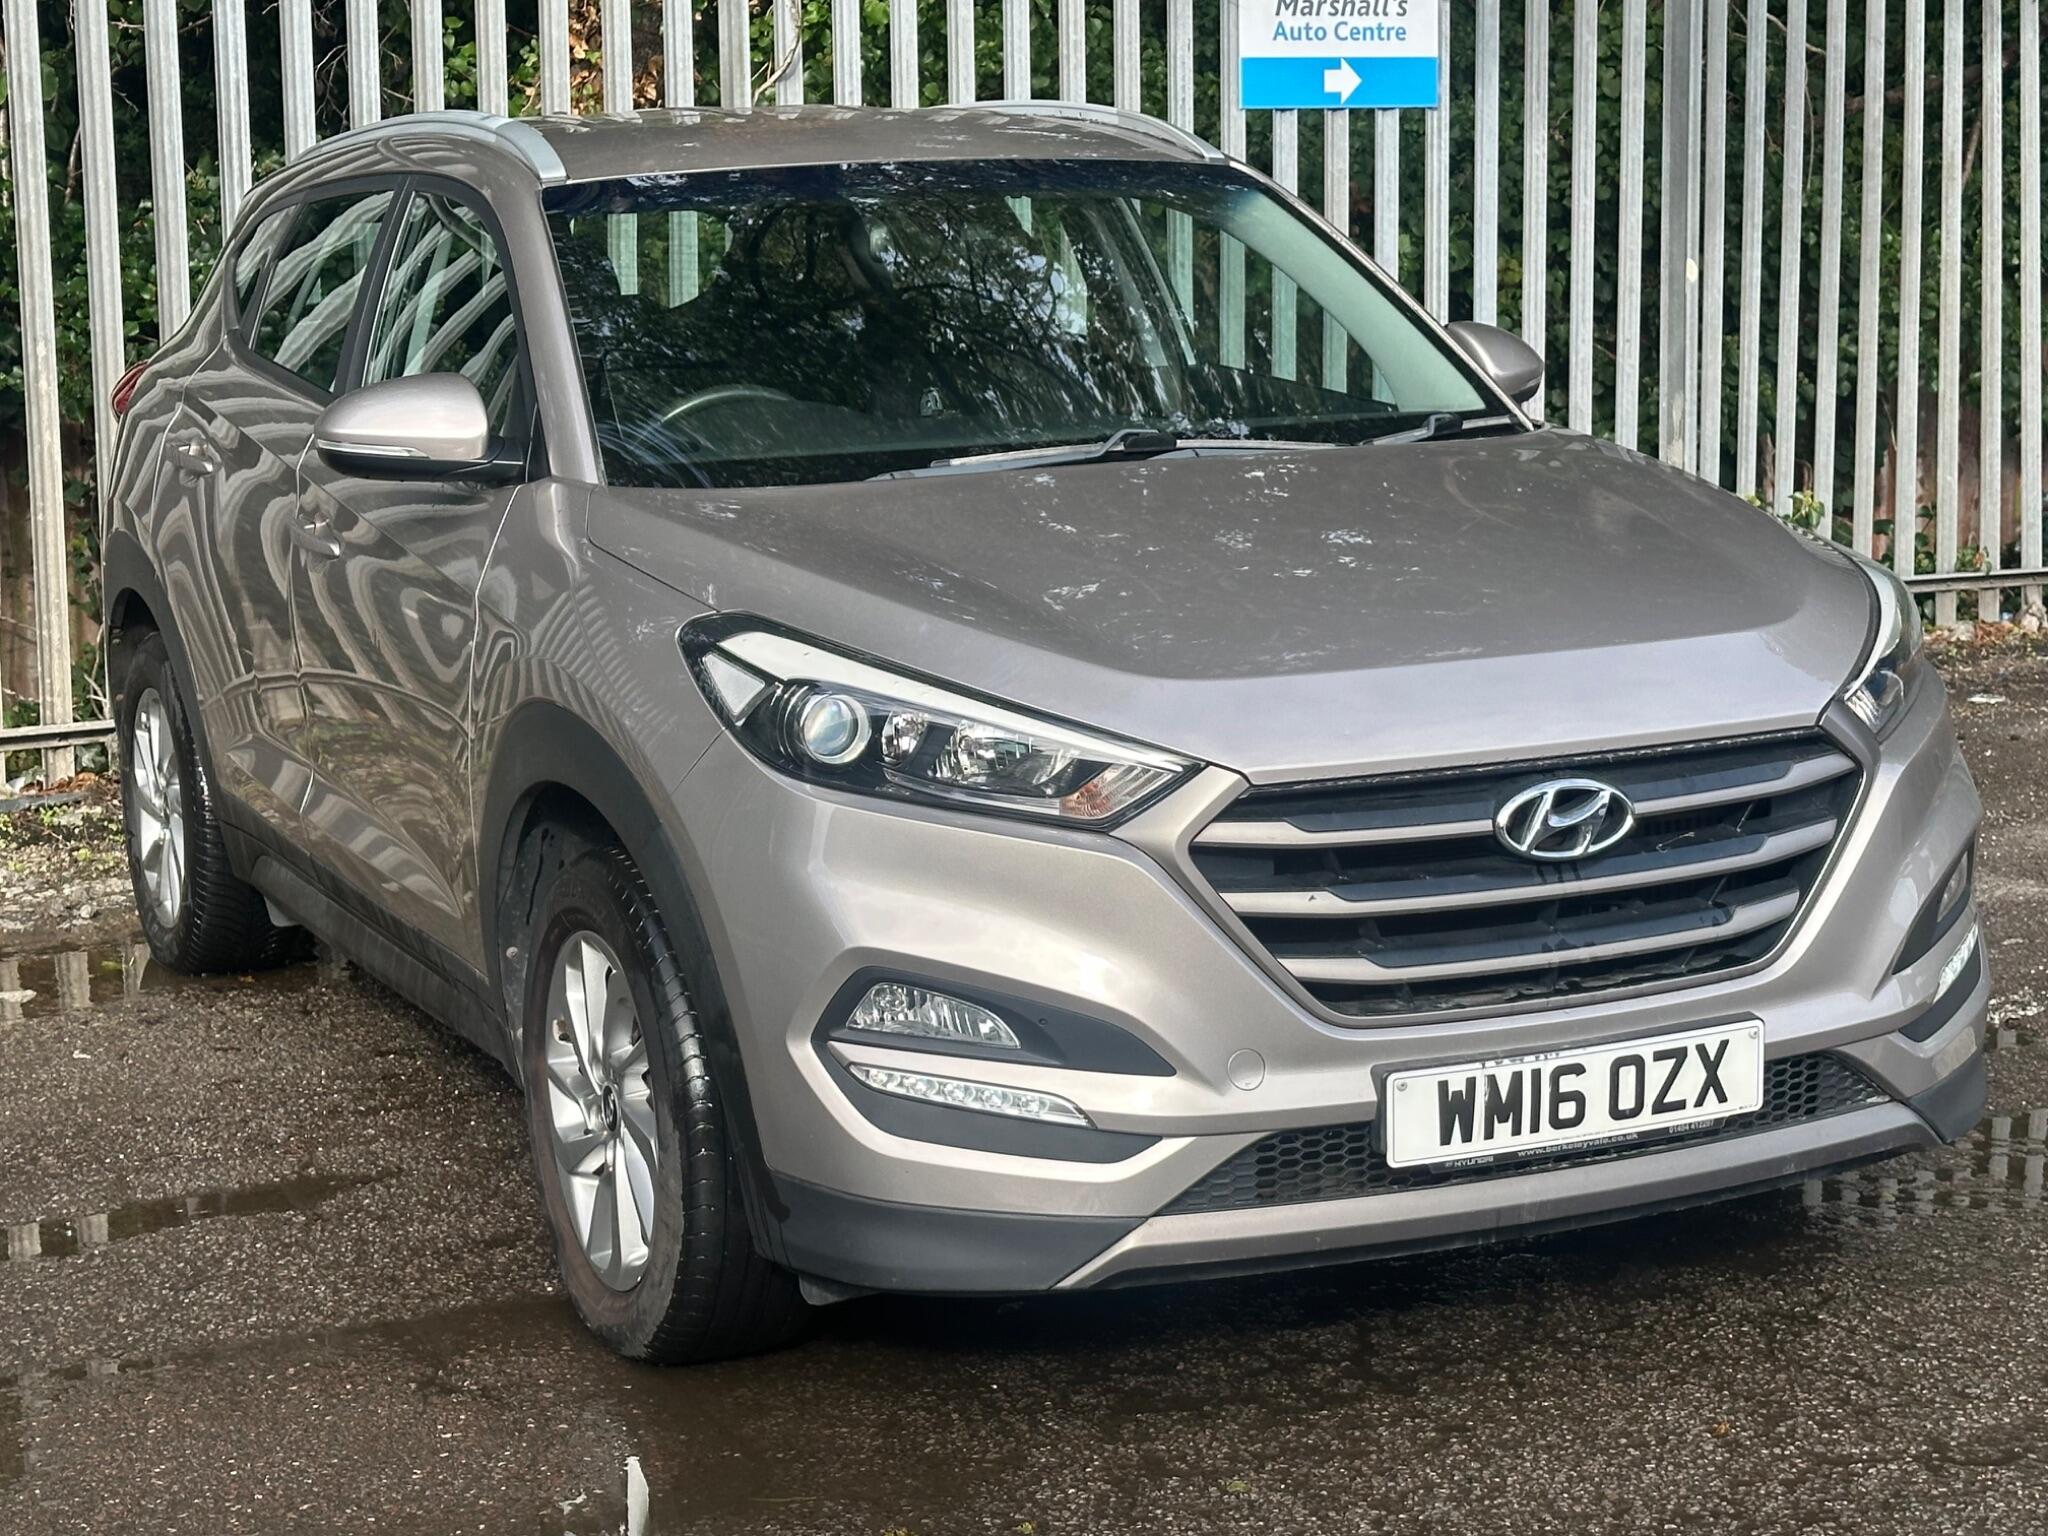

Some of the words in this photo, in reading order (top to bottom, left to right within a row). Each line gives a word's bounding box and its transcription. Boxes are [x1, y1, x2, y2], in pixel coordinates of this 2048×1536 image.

[1275, 0, 1408, 16] Marshall's
[1272, 21, 1327, 41] Auto
[1334, 21, 1407, 41] Centre
[1437, 1062, 1587, 1147] WM16
[1608, 1038, 1730, 1121] OZX
[1517, 1133, 1639, 1157] www.berkeleyvale.co.uk
